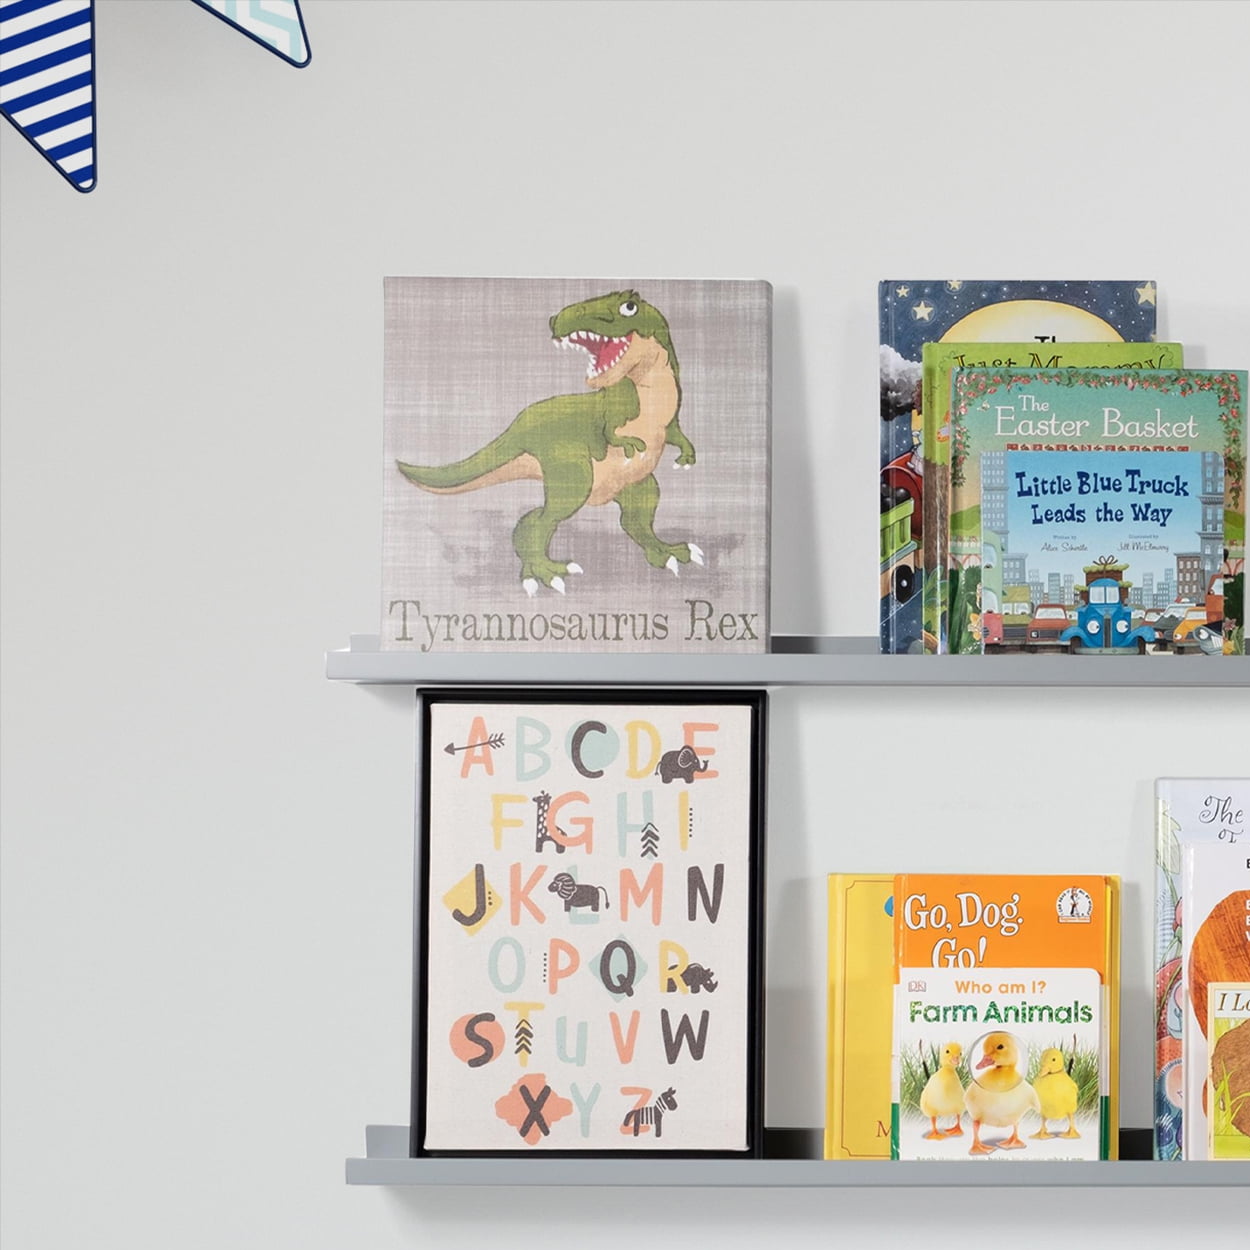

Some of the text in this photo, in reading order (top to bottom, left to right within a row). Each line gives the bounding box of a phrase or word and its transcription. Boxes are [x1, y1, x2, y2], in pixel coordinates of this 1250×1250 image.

[995, 405, 1200, 439] Easter Basket
[1018, 394, 1049, 413] The
[1015, 469, 1190, 498] Little Blue Truck
[1031, 502, 1173, 527] Leads the Way
[388, 599, 760, 653] Tyrannosaurus Rex
[460, 716, 495, 779] A
[514, 716, 552, 782] B
[570, 720, 608, 779] C
[624, 719, 662, 780] D
[490, 793, 529, 852] F
[546, 790, 595, 855] G
[678, 790, 690, 852] I
[1199, 795, 1245, 825] The
[452, 863, 487, 927] J
[509, 861, 549, 926] K
[619, 862, 664, 926] M
[687, 863, 725, 924] N
[903, 892, 953, 933] Go,
[955, 891, 1025, 937] Dog.
[488, 936, 691, 998] O P Q R
[955, 980, 1047, 994] Who am I?
[909, 1000, 1094, 1024] Farm Animals
[1217, 992, 1228, 1012] I
[464, 1012, 496, 1068] S
[504, 1001, 546, 1068] T
[609, 1010, 640, 1065] V
[660, 1007, 710, 1065] W
[518, 1083, 551, 1138] X
[570, 1082, 602, 1139] Y
